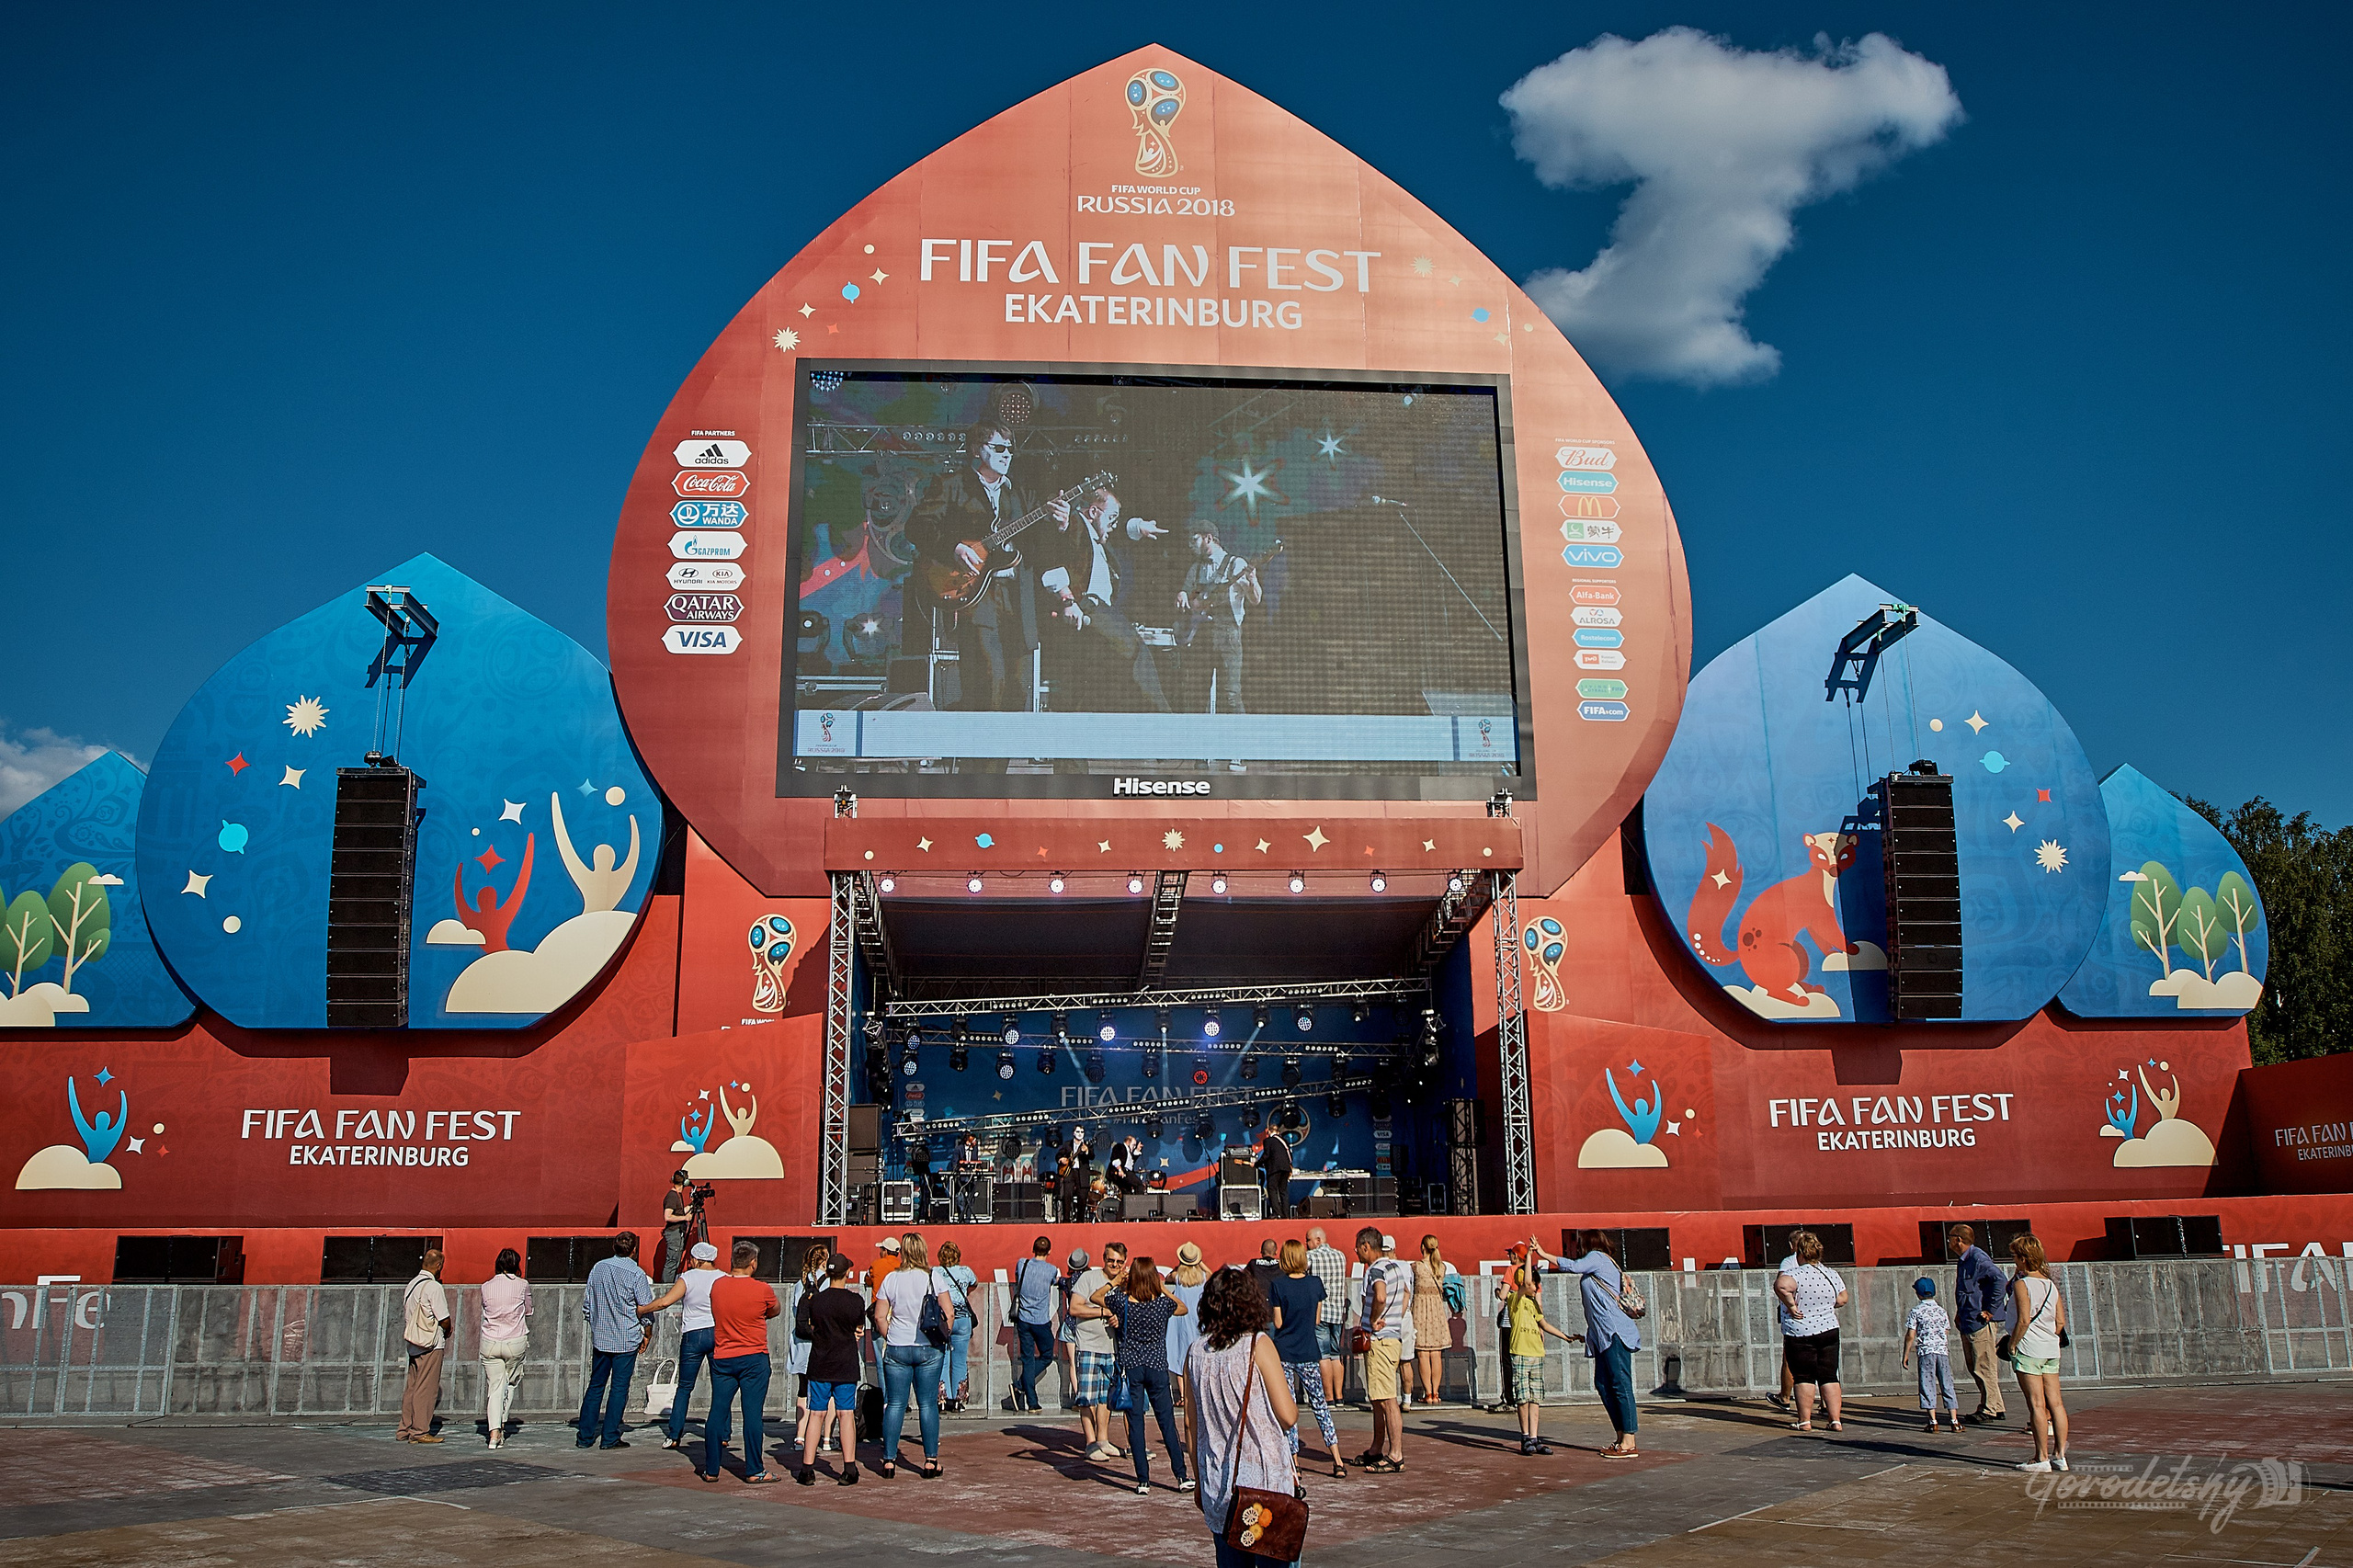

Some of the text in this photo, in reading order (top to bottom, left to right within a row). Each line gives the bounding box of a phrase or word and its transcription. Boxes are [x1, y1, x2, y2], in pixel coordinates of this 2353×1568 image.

[1111, 185, 1201, 195] FIFA WORLD CUP
[1077, 195, 1235, 217] RUSSIA 2018
[921, 238, 1381, 293] FIFA FAN FEST
[1005, 292, 1302, 330] EKATERINBURG
[1560, 449, 1610, 467] Bud
[1563, 477, 1612, 487] Hisense
[702, 504, 739, 517] 万达
[698, 548, 731, 556] GAZPROM
[1568, 548, 1617, 562] vivo
[1576, 591, 1615, 599] Alfa-Bank
[671, 596, 734, 613] QATAR
[687, 610, 734, 619] AIRWAYS
[1579, 617, 1616, 625] ALROSA
[676, 631, 727, 648] VISA
[1112, 777, 1211, 797] Hisense
[1061, 1086, 1118, 1107] FIFA
[1126, 1086, 1182, 1106] FAN
[1769, 1093, 2014, 1127] FIFA FAN FEST
[241, 1109, 521, 1141] FIFA FAN FEST
[1817, 1128, 1976, 1151] EKATERINBURG
[2275, 1126, 2310, 1147] FIFA
[2312, 1122, 2346, 1143] FAN
[289, 1145, 469, 1166] EKATERINBURG
[2298, 1144, 2353, 1161] EKATERINB
[2222, 1243, 2337, 1292] IFA
